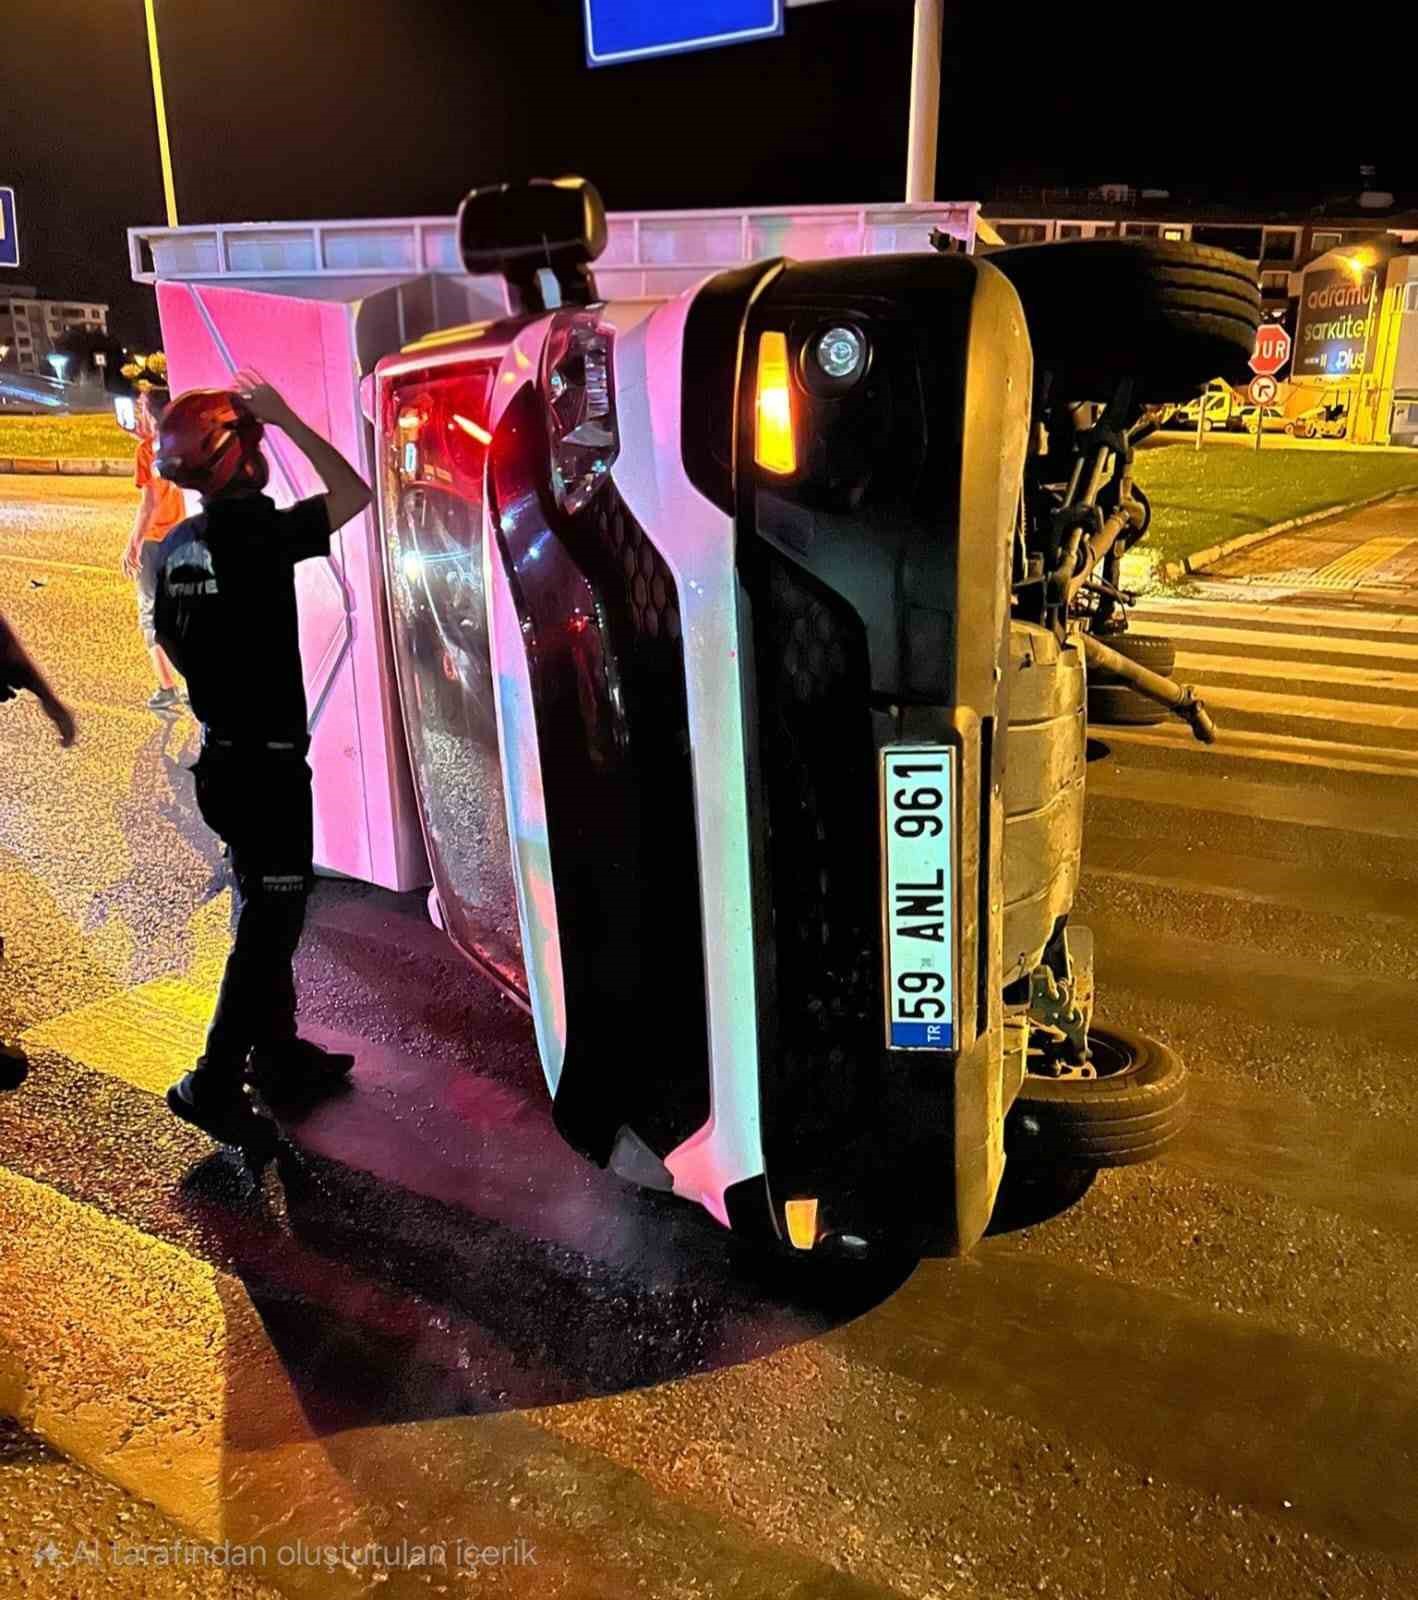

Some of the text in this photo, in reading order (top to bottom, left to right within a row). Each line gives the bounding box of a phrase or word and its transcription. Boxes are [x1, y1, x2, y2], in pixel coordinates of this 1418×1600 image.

[892, 763, 946, 1019] 59 ANL 961
[927, 1024, 942, 1043] TR
